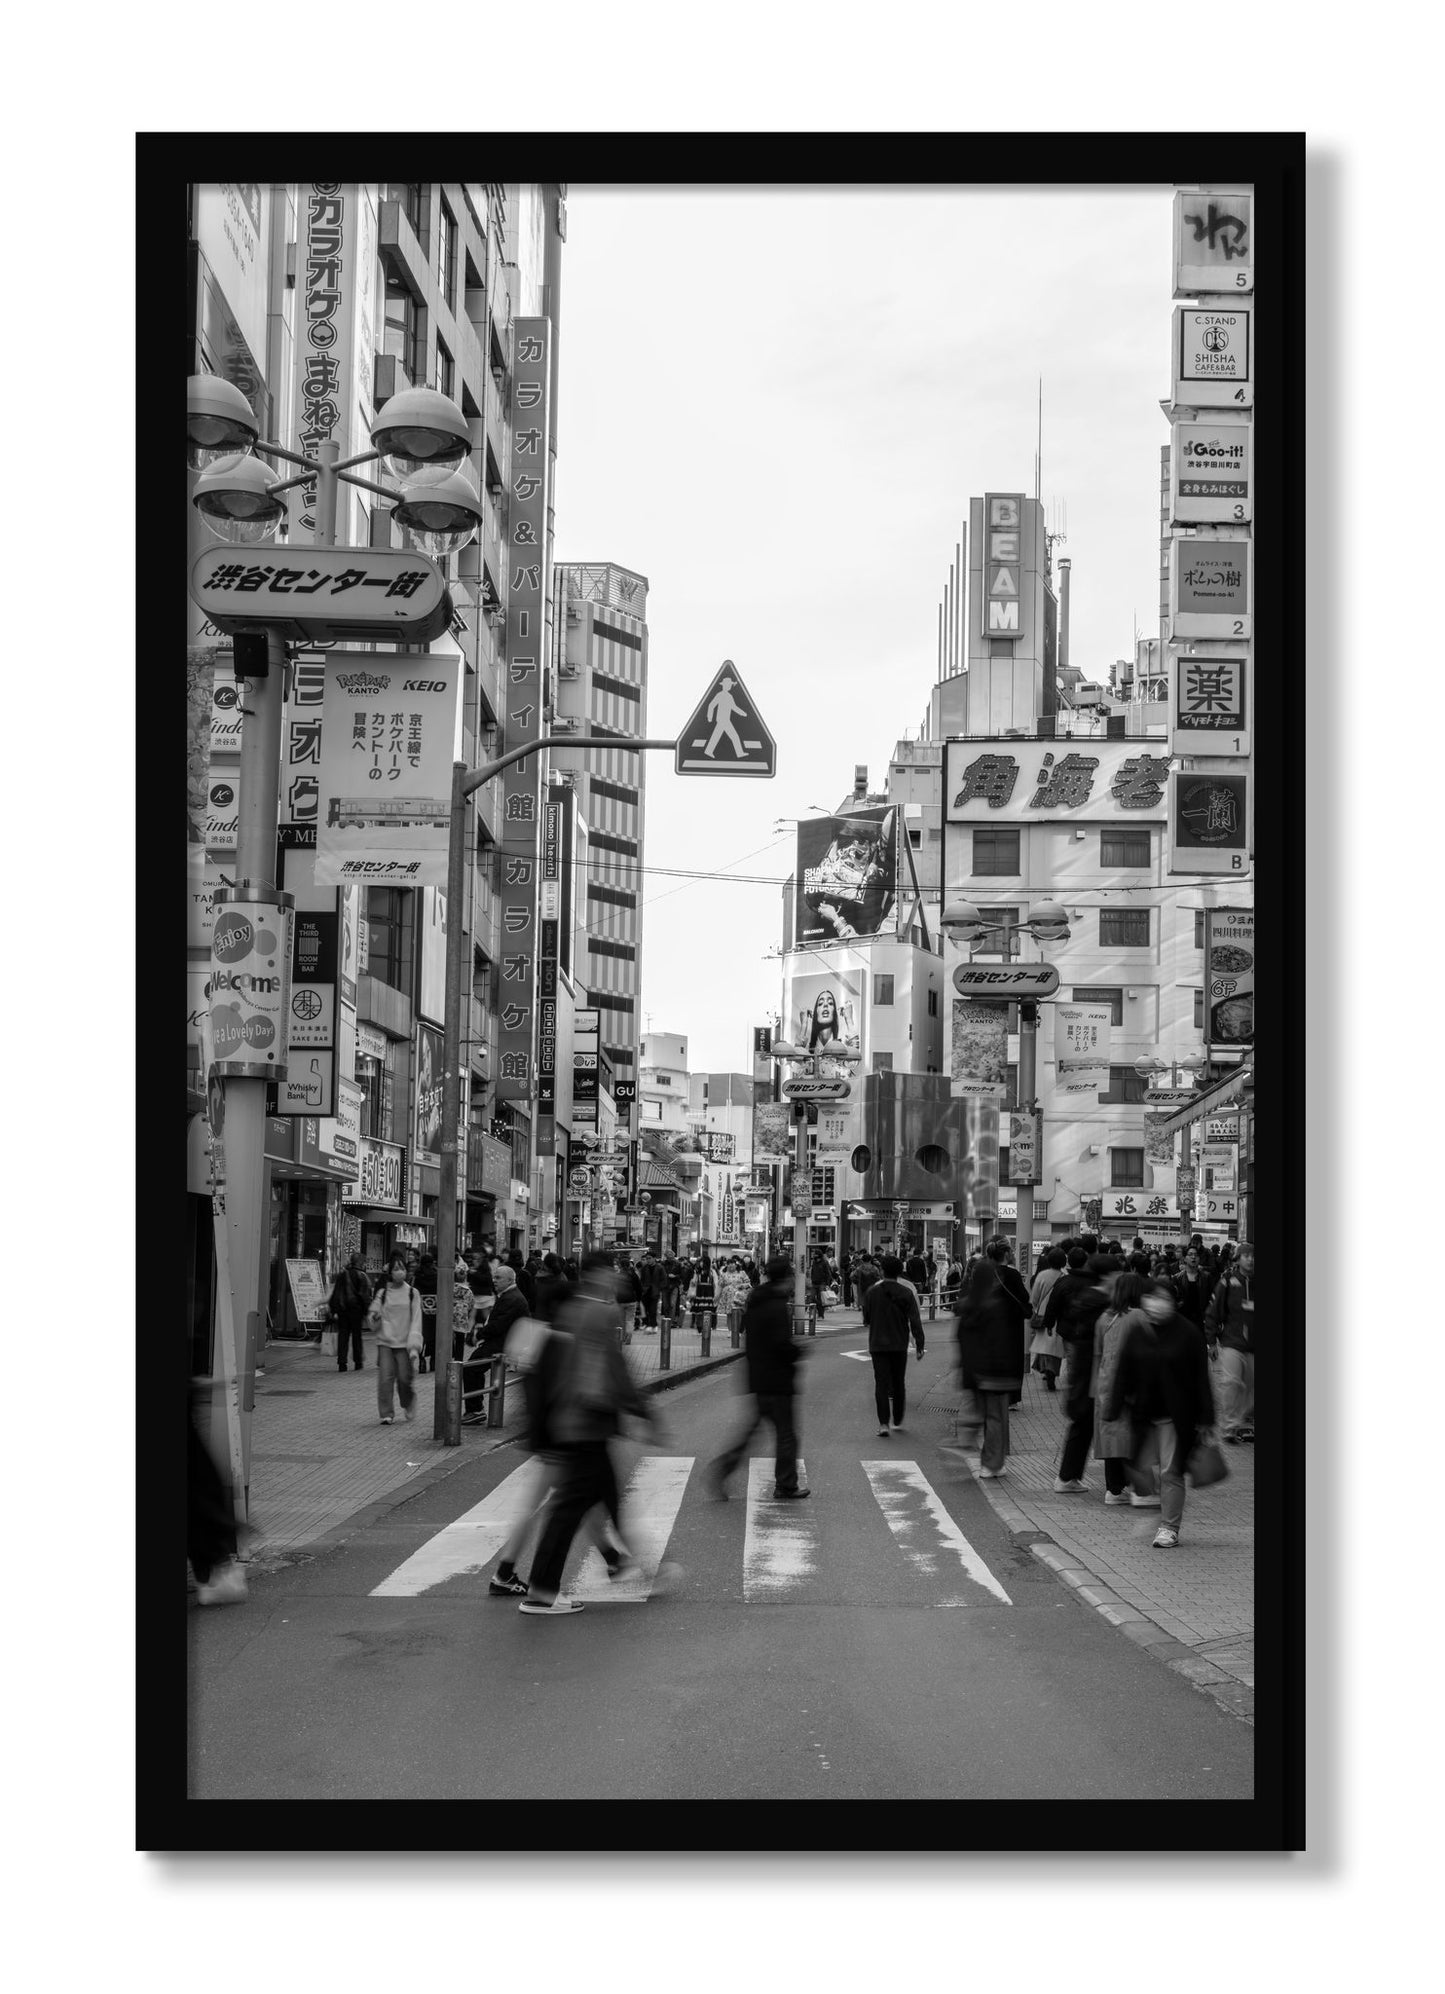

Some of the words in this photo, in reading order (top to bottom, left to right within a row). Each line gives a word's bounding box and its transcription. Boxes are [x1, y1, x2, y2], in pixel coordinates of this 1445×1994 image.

[305, 196, 344, 321] カラオケ
[1236, 273, 1246, 288] 5
[1195, 316, 1237, 326] C.STAND
[1195, 353, 1236, 363] SHISHA
[1195, 363, 1236, 372] CAFE&BAR
[1234, 388, 1246, 403] 4
[1183, 483, 1245, 495] 全身もみほぐし
[1233, 504, 1245, 520] 3
[990, 499, 1019, 631] BEAM
[202, 563, 431, 599] 渋谷センター街
[1233, 620, 1245, 635] 2
[348, 687, 380, 695] KANTO
[403, 680, 447, 693] KEIO
[1186, 665, 1233, 712] 薬
[352, 712, 367, 752] 冒険へ
[369, 713, 385, 780] カントーの
[408, 713, 423, 768] 京王線で
[1233, 738, 1241, 752] 1
[953, 753, 1170, 809] 角海老
[547, 807, 557, 840] kimono
[340, 861, 421, 873] 渋谷センター街
[546, 844, 556, 876] hearts
[1231, 855, 1242, 870] B
[213, 924, 251, 957] Enjoy
[301, 965, 315, 973] BAR
[210, 970, 281, 993] Welcome
[960, 971, 1053, 984] 渋谷センター街
[1211, 980, 1238, 998] 6F
[227, 1022, 254, 1041] Lovely
[255, 1023, 274, 1037] Day!
[287, 1091, 306, 1099] Bank
[288, 1082, 319, 1095] Whisky
[616, 1087, 635, 1096] GU
